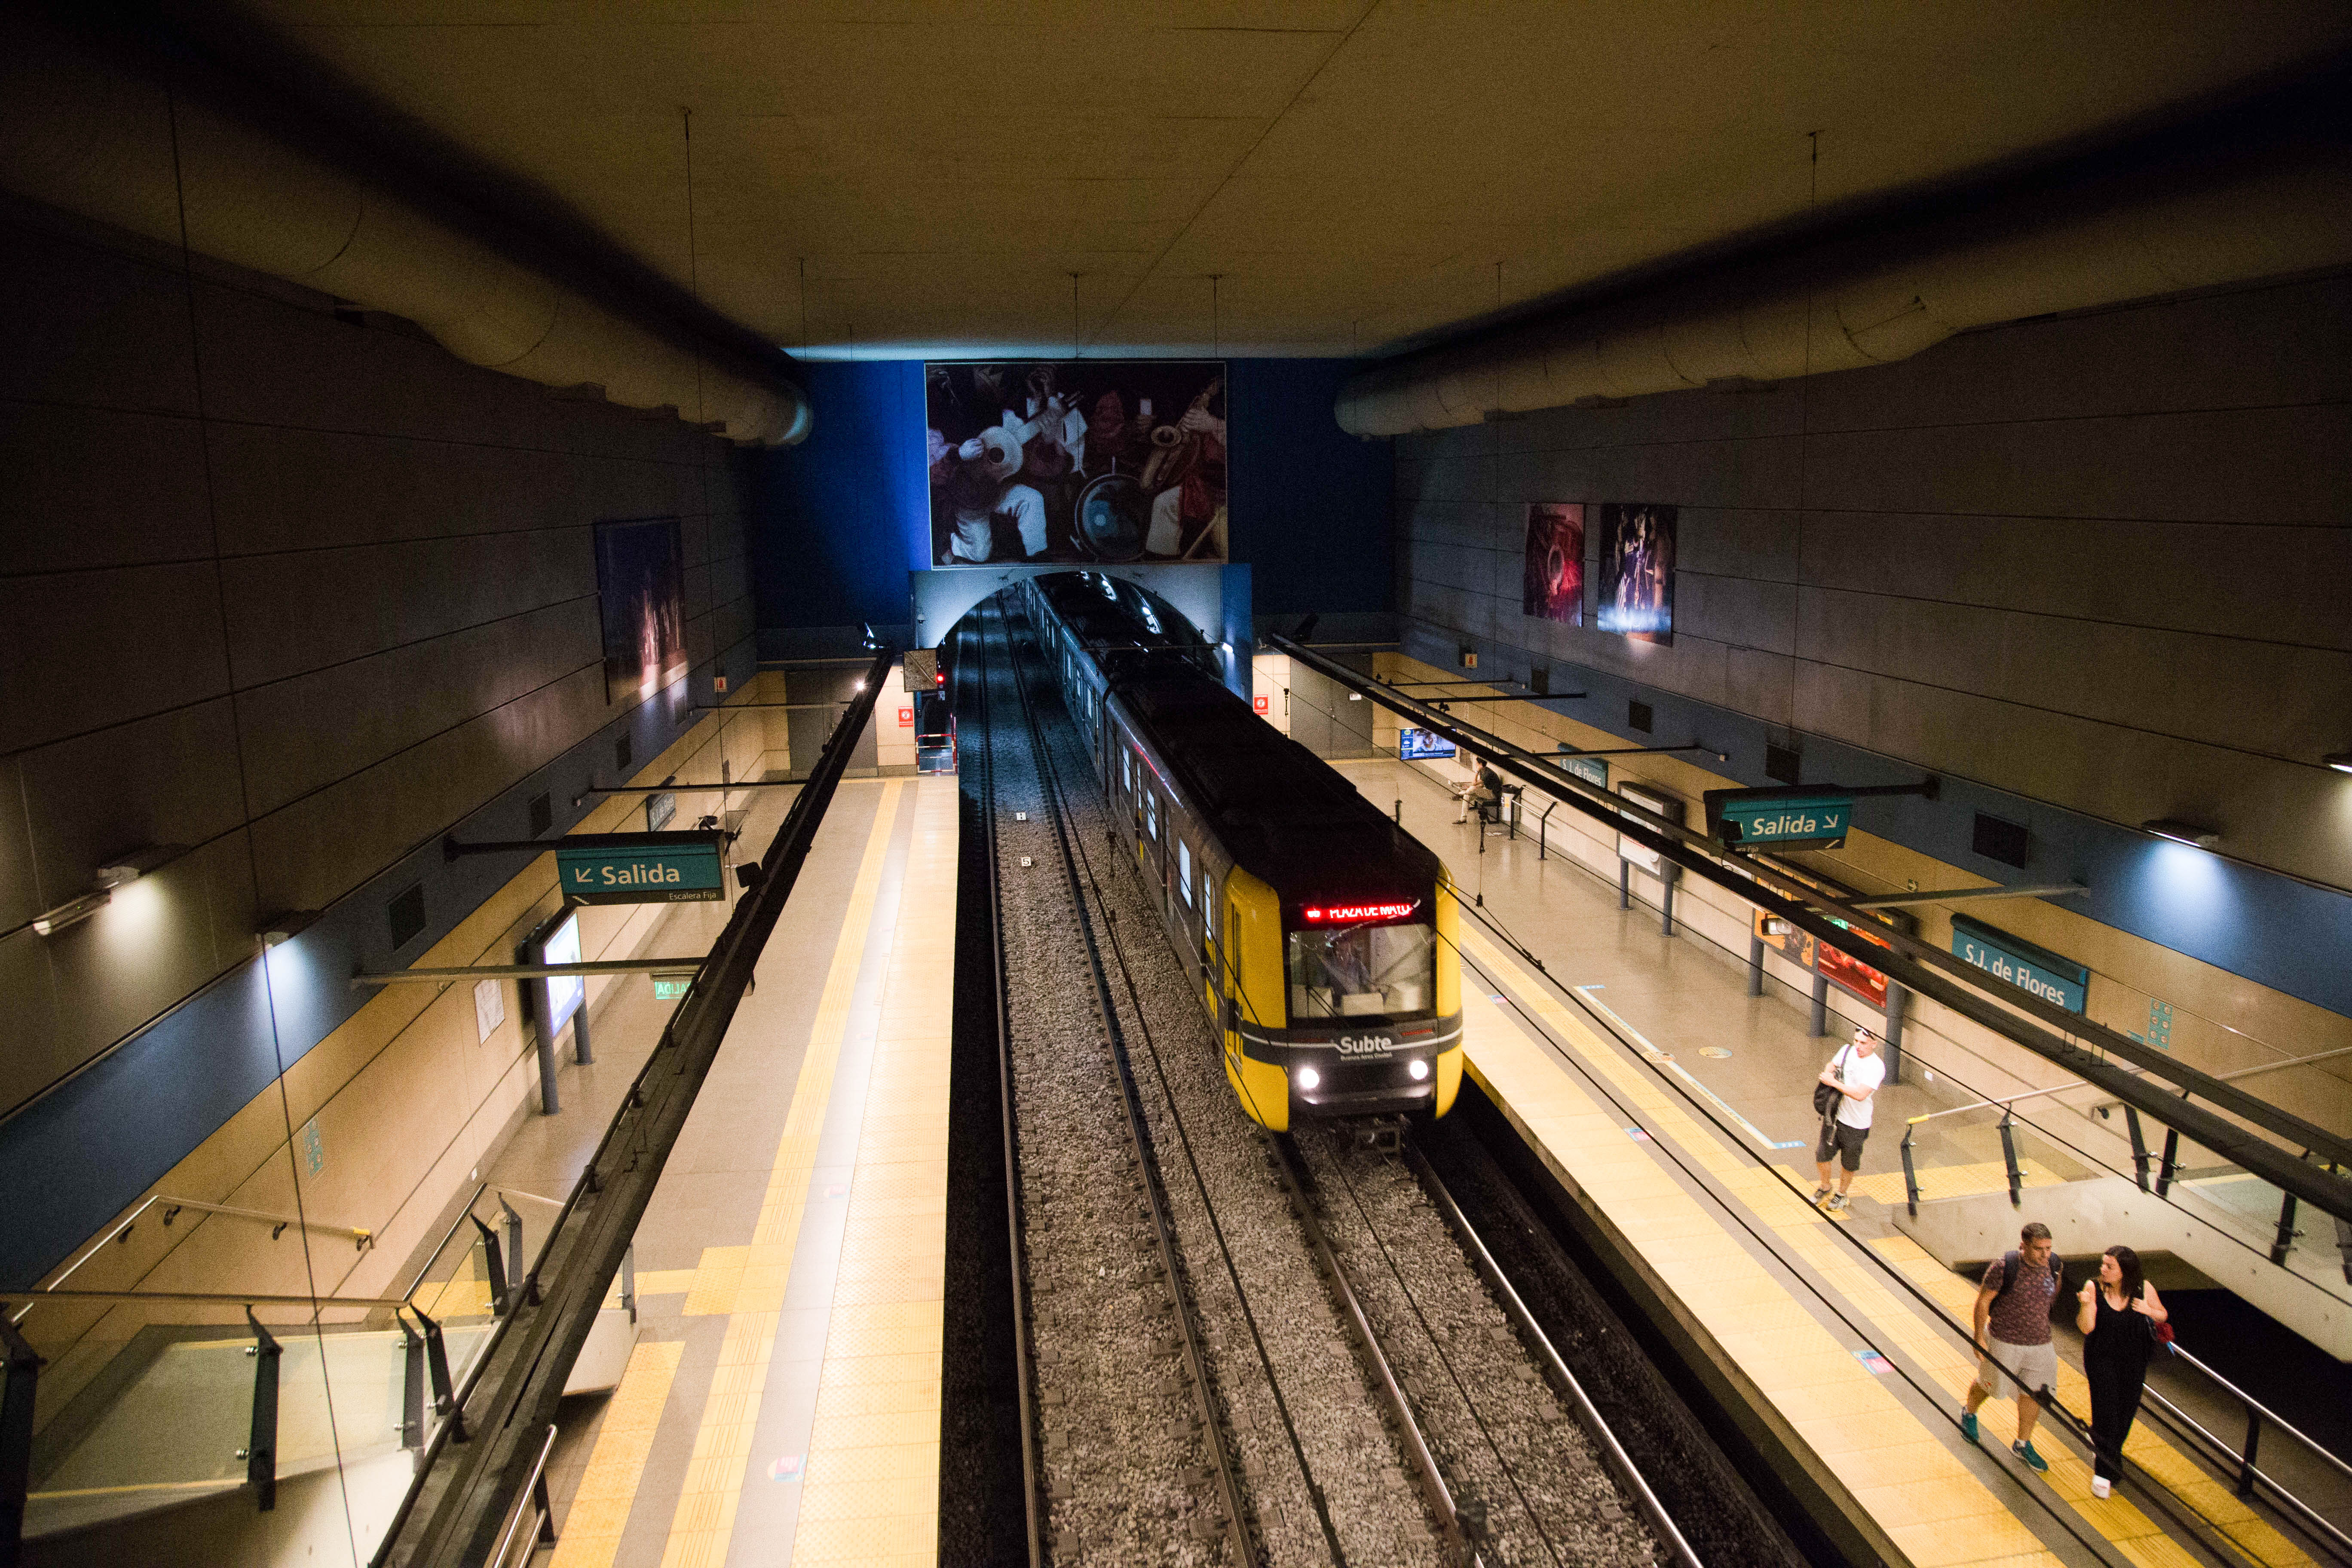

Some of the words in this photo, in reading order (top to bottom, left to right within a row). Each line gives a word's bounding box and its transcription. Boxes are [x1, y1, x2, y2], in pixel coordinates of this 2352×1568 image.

[1575, 764, 1582, 777] de
[1584, 768, 1601, 786] Flores
[1752, 815, 1816, 835] Salida
[602, 864, 680, 885] Salida
[703, 891, 716, 900] Fija
[1993, 957, 2012, 981] de
[2017, 967, 2065, 1006] Flores
[1341, 1035, 1391, 1054] Subte
